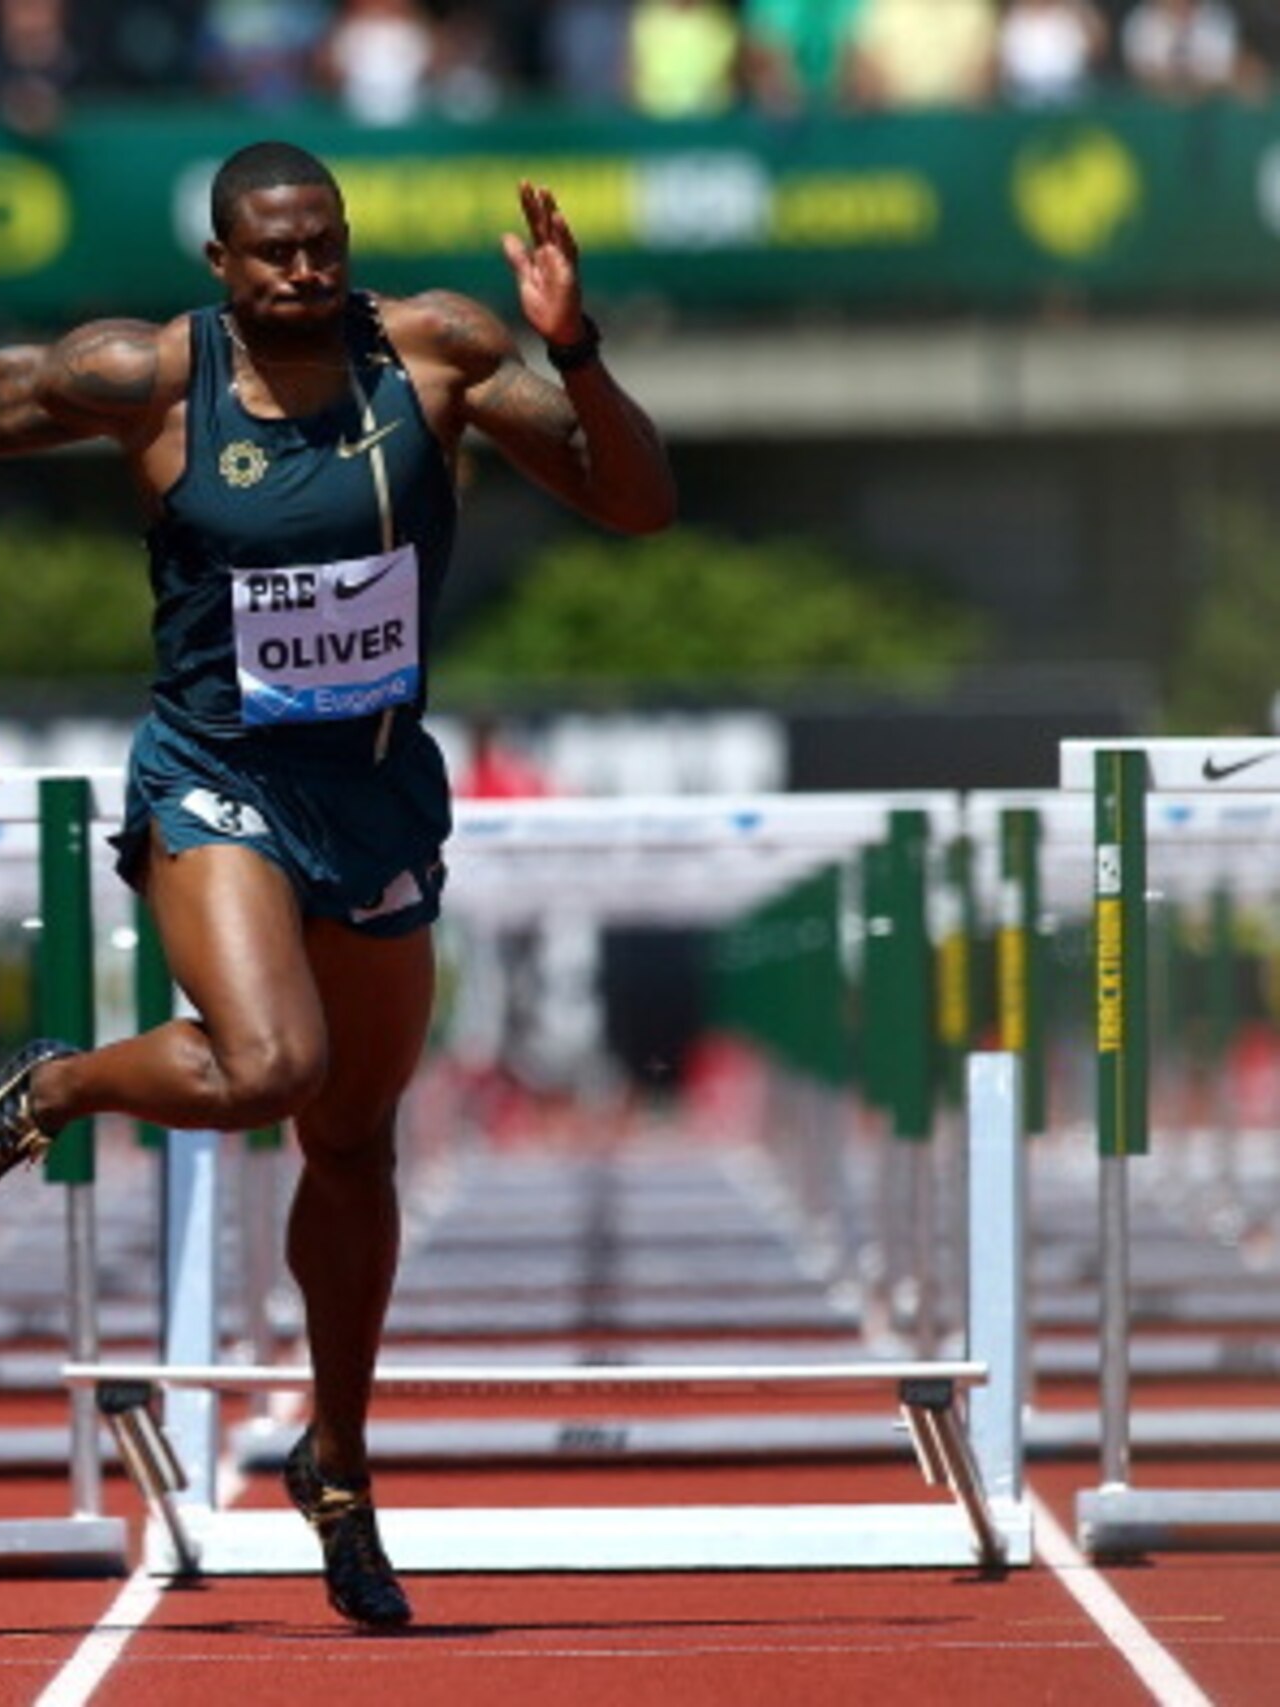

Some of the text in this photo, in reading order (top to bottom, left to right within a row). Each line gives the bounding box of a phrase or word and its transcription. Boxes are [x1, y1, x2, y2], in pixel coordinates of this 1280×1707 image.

[246, 573, 316, 613] PRE
[258, 619, 405, 671] OLIVER
[216, 793, 243, 832] 3
